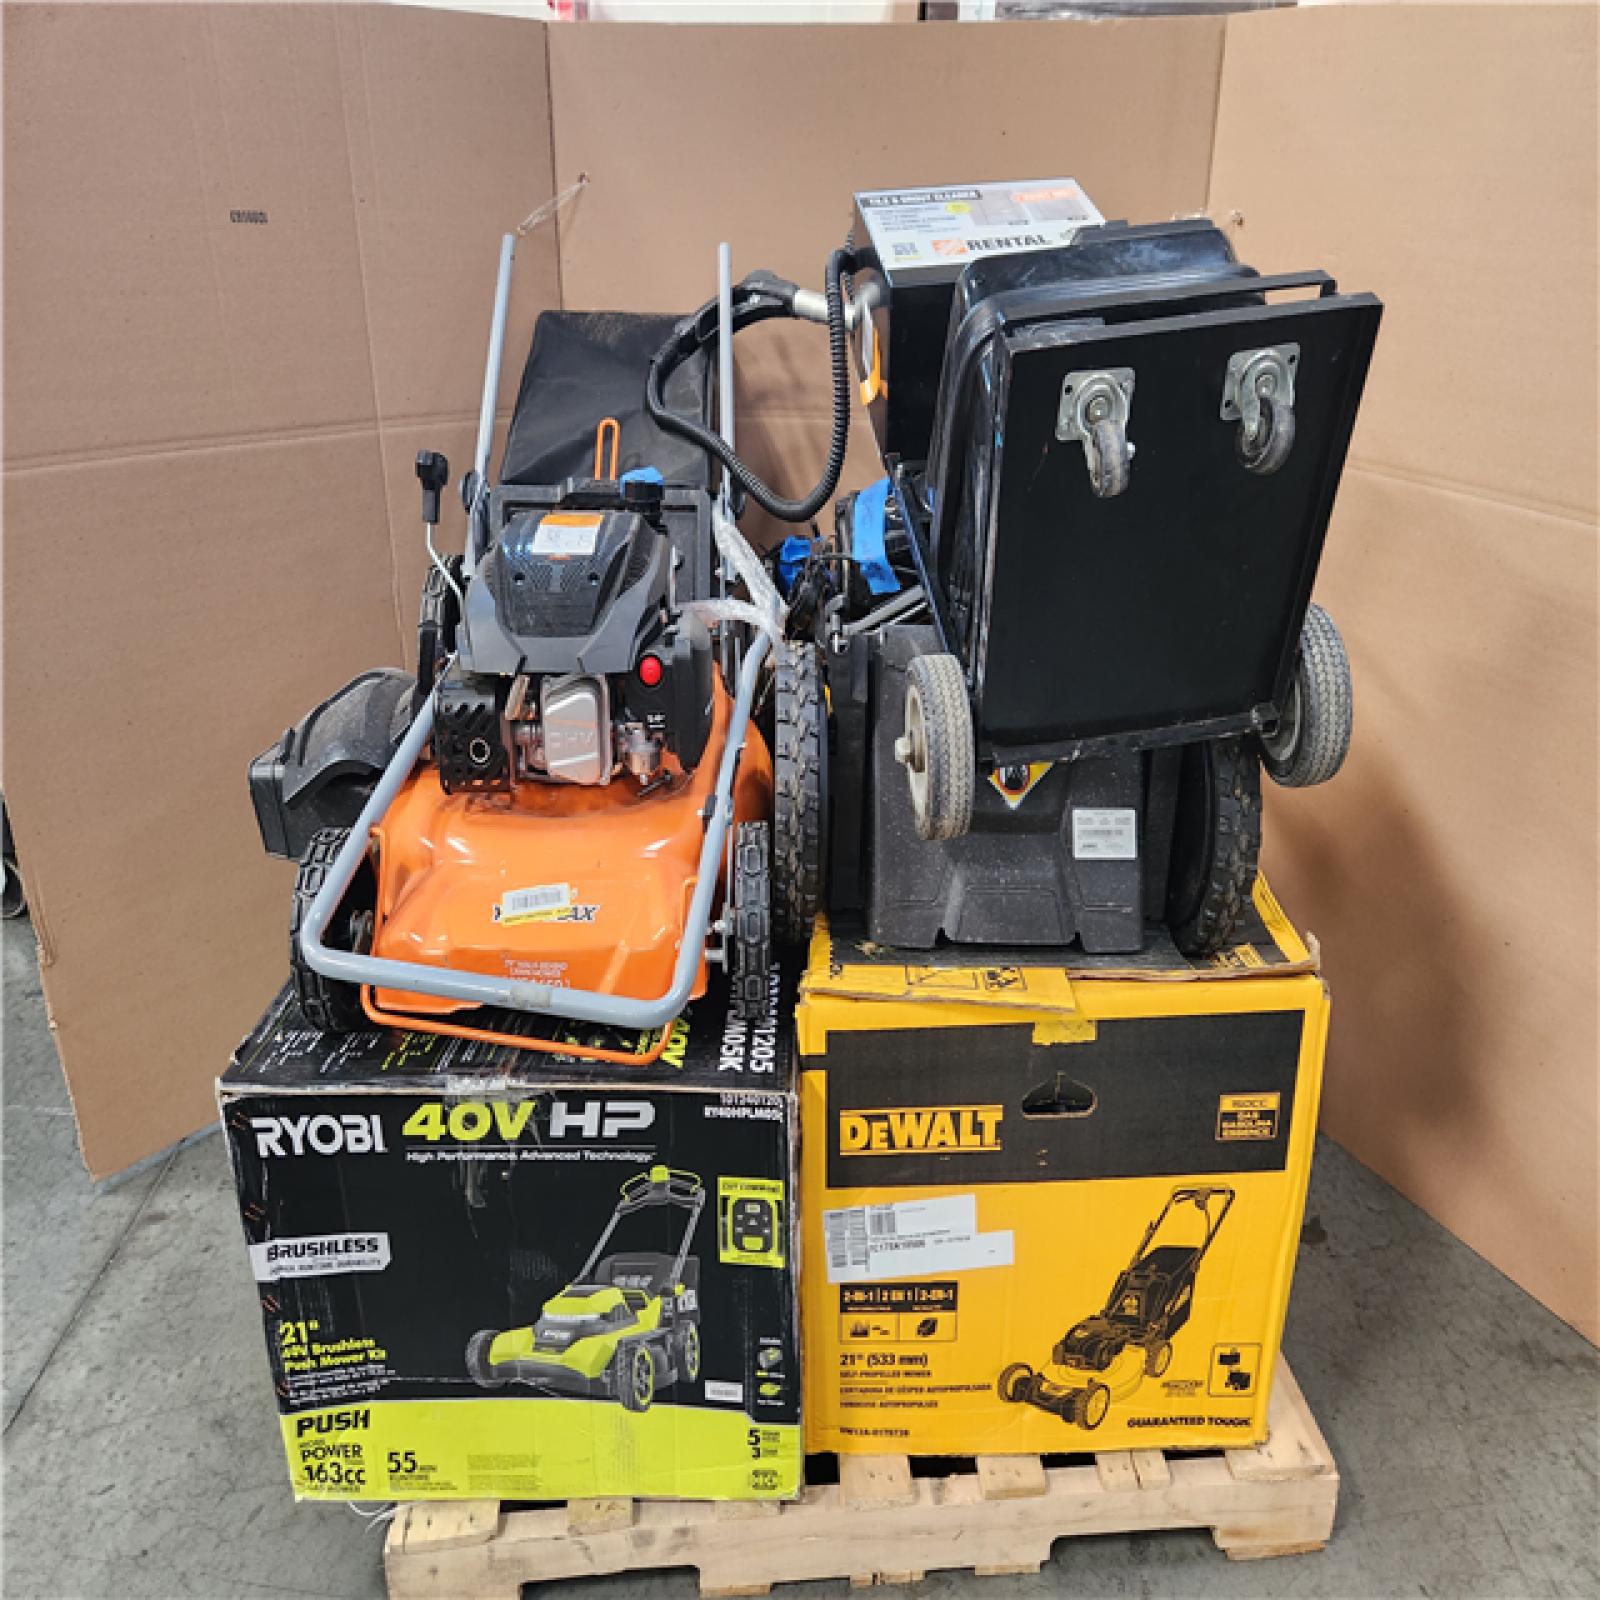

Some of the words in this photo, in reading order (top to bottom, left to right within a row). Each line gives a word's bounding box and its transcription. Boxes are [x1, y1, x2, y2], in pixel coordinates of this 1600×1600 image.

[966, 234, 1051, 252] RENTAL
[402, 1101, 537, 1141] 40V
[549, 1101, 656, 1139] HP
[251, 1114, 388, 1158] RYOBI
[407, 1152, 434, 1163] High
[437, 1151, 519, 1162] Performance
[520, 1151, 581, 1161] Advanced
[584, 1150, 654, 1164] Technology
[266, 1236, 379, 1262] BRUSHLESS
[279, 1319, 320, 1345] 21"
[312, 1337, 376, 1356] Brushless
[284, 1357, 317, 1373] Push
[319, 1353, 366, 1367] Mower
[839, 1354, 864, 1366] 21"
[867, 1353, 896, 1367] (533
[898, 1353, 928, 1367] mm)
[296, 1408, 370, 1438] PUSH
[1127, 1415, 1206, 1428] GUARANTEED
[747, 1428, 761, 1446] 5
[300, 1444, 363, 1462] POWER
[387, 1451, 417, 1473] 55
